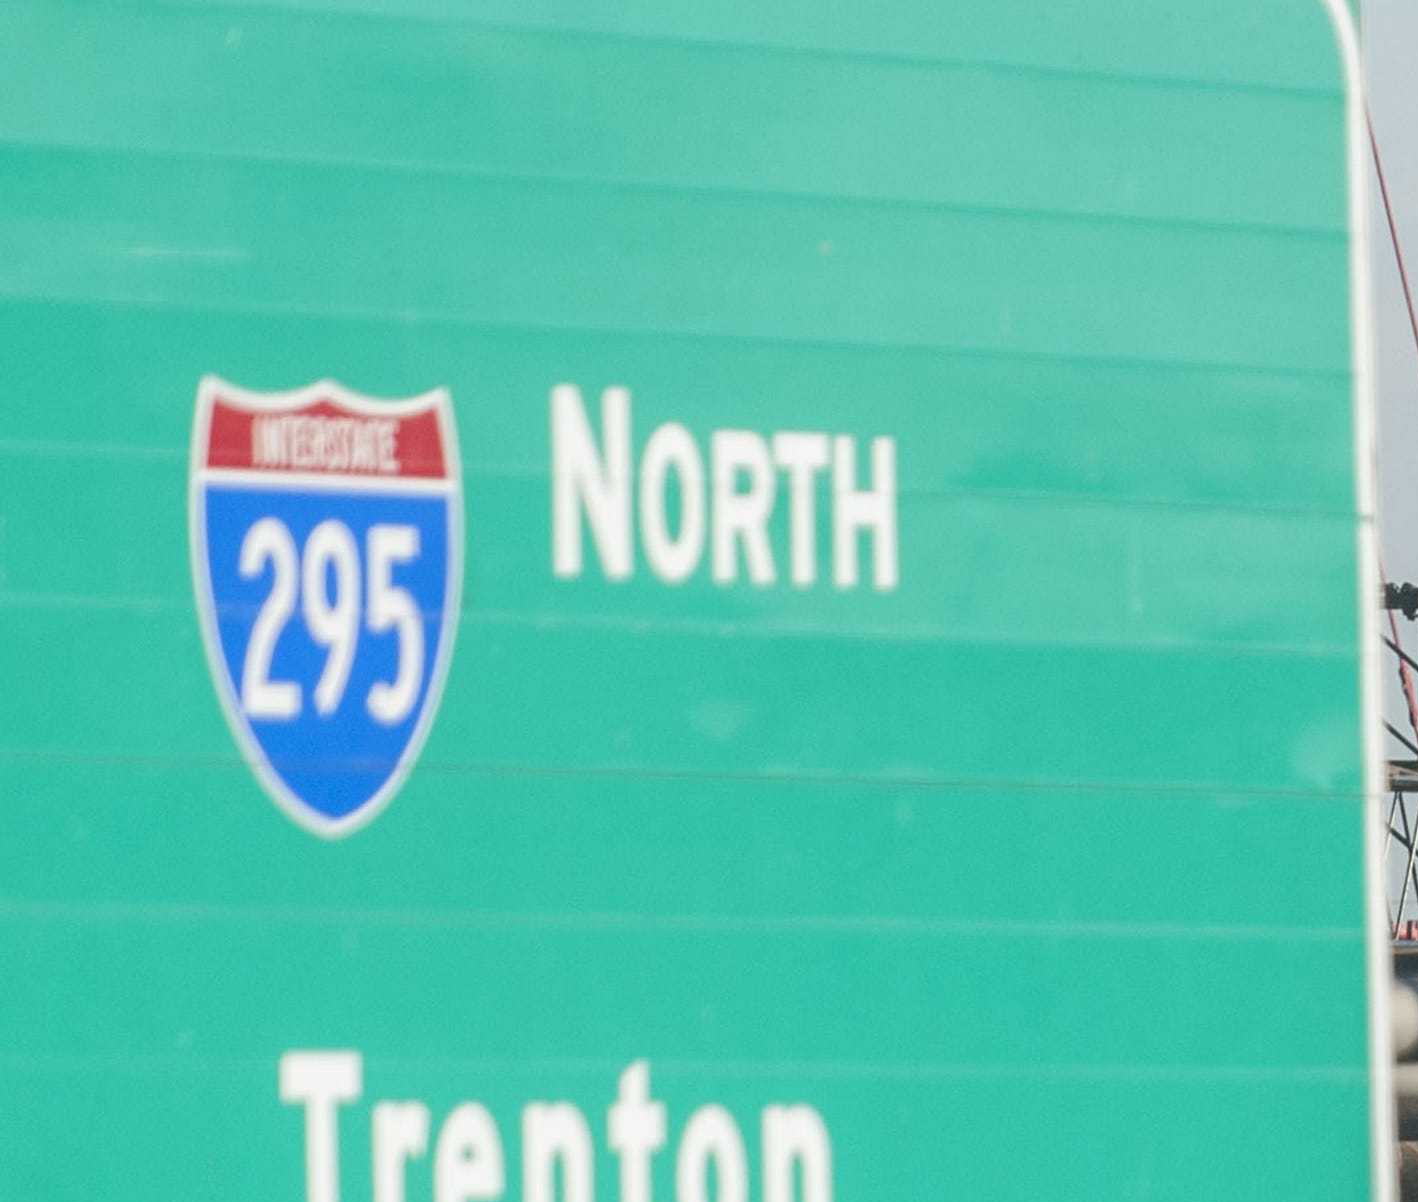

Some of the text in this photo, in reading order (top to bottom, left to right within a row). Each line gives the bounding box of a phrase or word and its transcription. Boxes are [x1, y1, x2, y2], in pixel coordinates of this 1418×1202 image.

[252, 415, 401, 470] INTERSTATE
[549, 382, 900, 592] NORTH
[238, 516, 425, 724] 295
